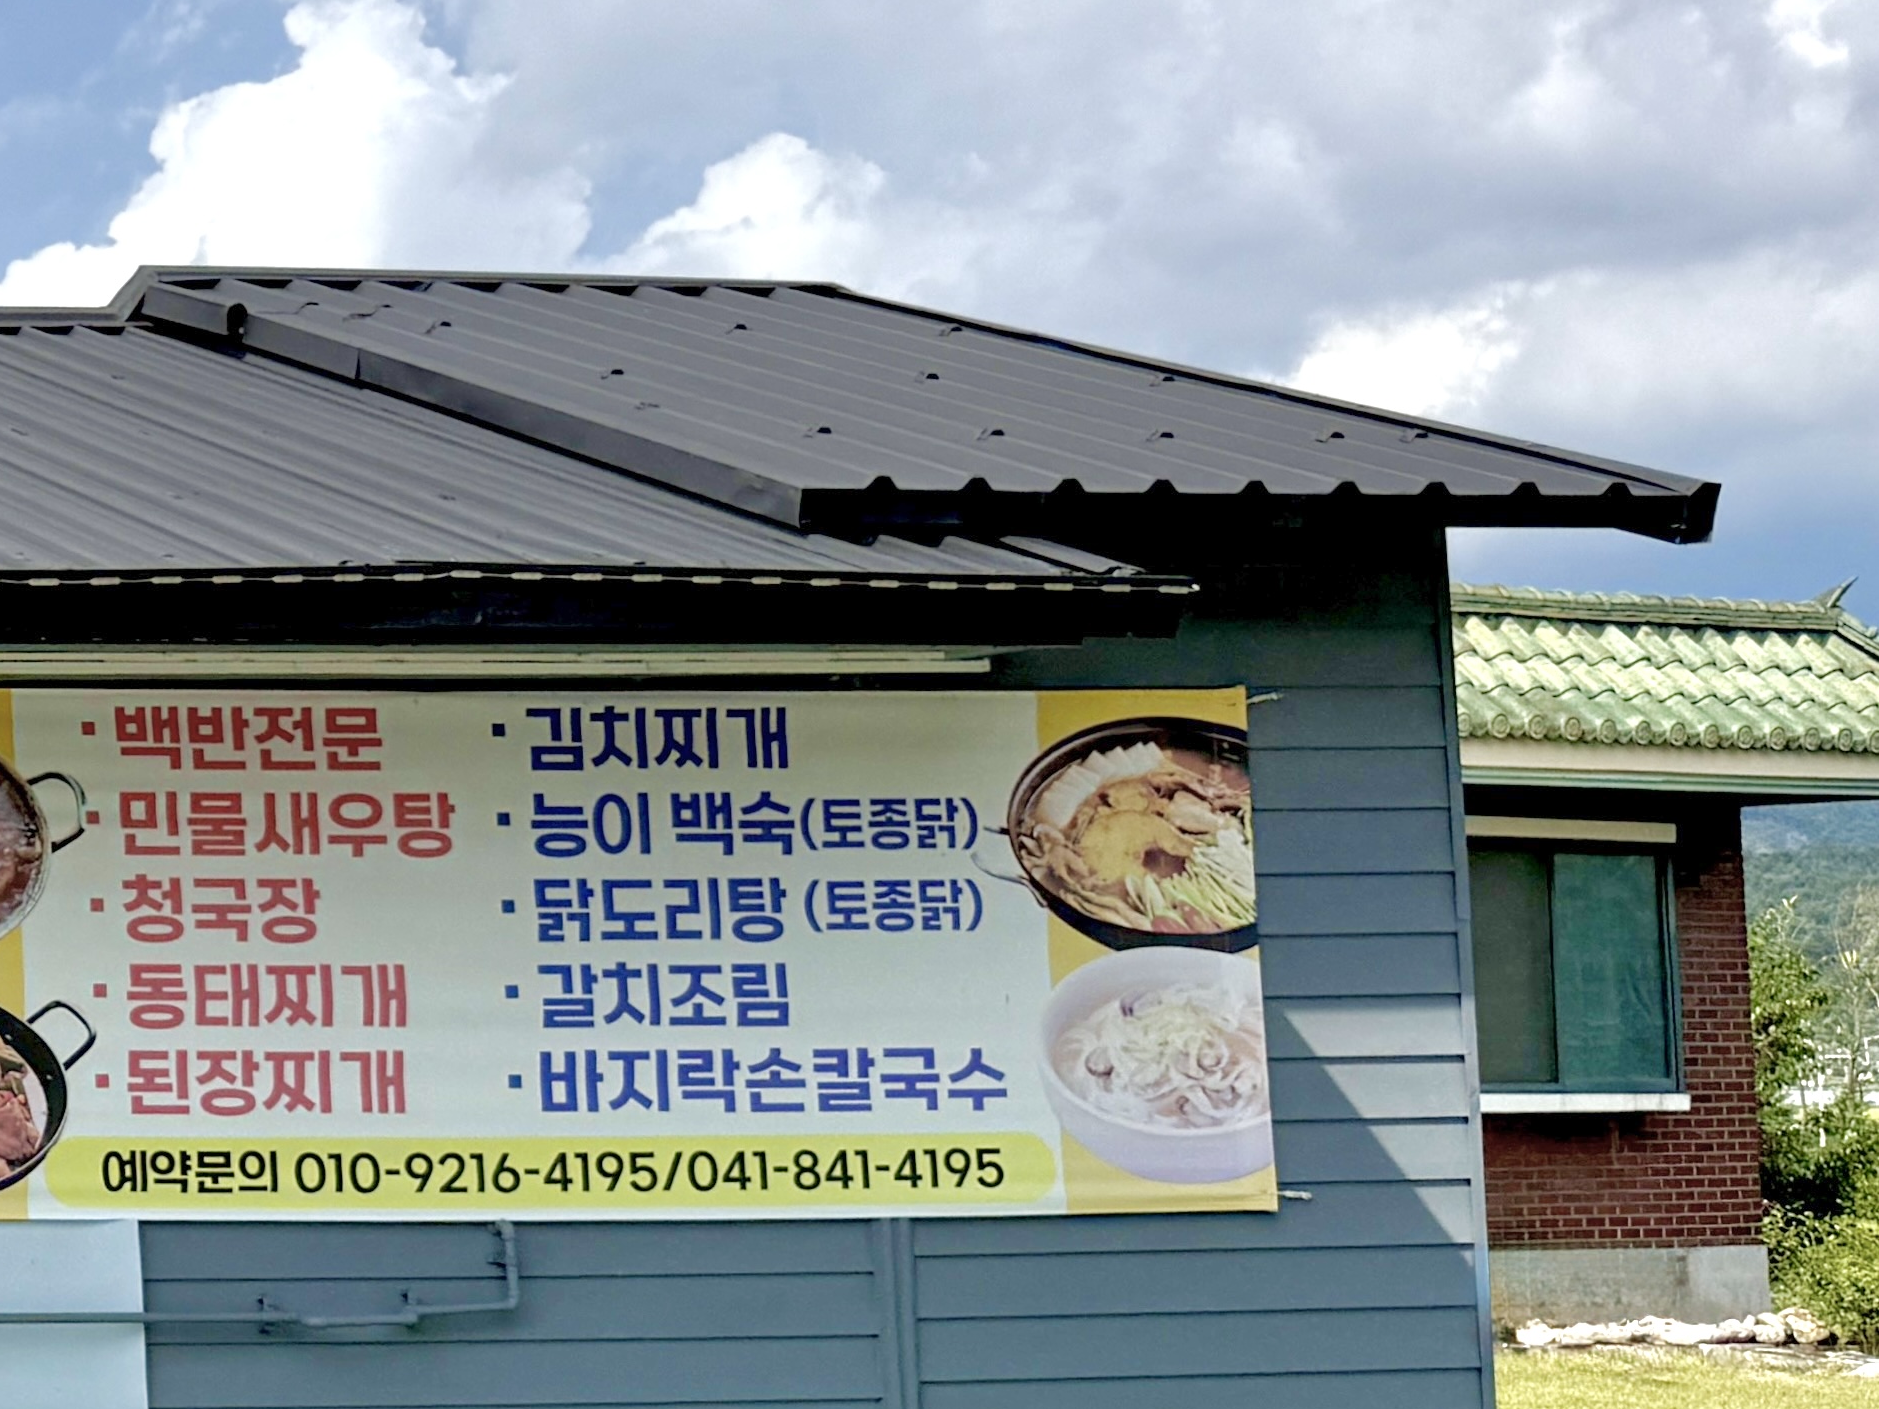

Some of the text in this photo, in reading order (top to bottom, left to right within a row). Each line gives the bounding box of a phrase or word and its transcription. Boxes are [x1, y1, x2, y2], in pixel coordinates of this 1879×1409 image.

[114, 705, 383, 771] 백반전문
[525, 705, 789, 771] 김치찌개
[118, 790, 456, 859] 민물새우탕
[530, 792, 652, 858] 능이
[121, 873, 322, 944] 청국장
[532, 877, 984, 944] 닭도리탕 (토종닭)
[126, 962, 409, 1030] 동태찌개
[537, 960, 791, 1029] 갈치조림
[126, 1048, 407, 1117] 된장찌개
[538, 1046, 1009, 1114] 바지락손칼국수
[101, 1149, 279, 1194] 예약문의
